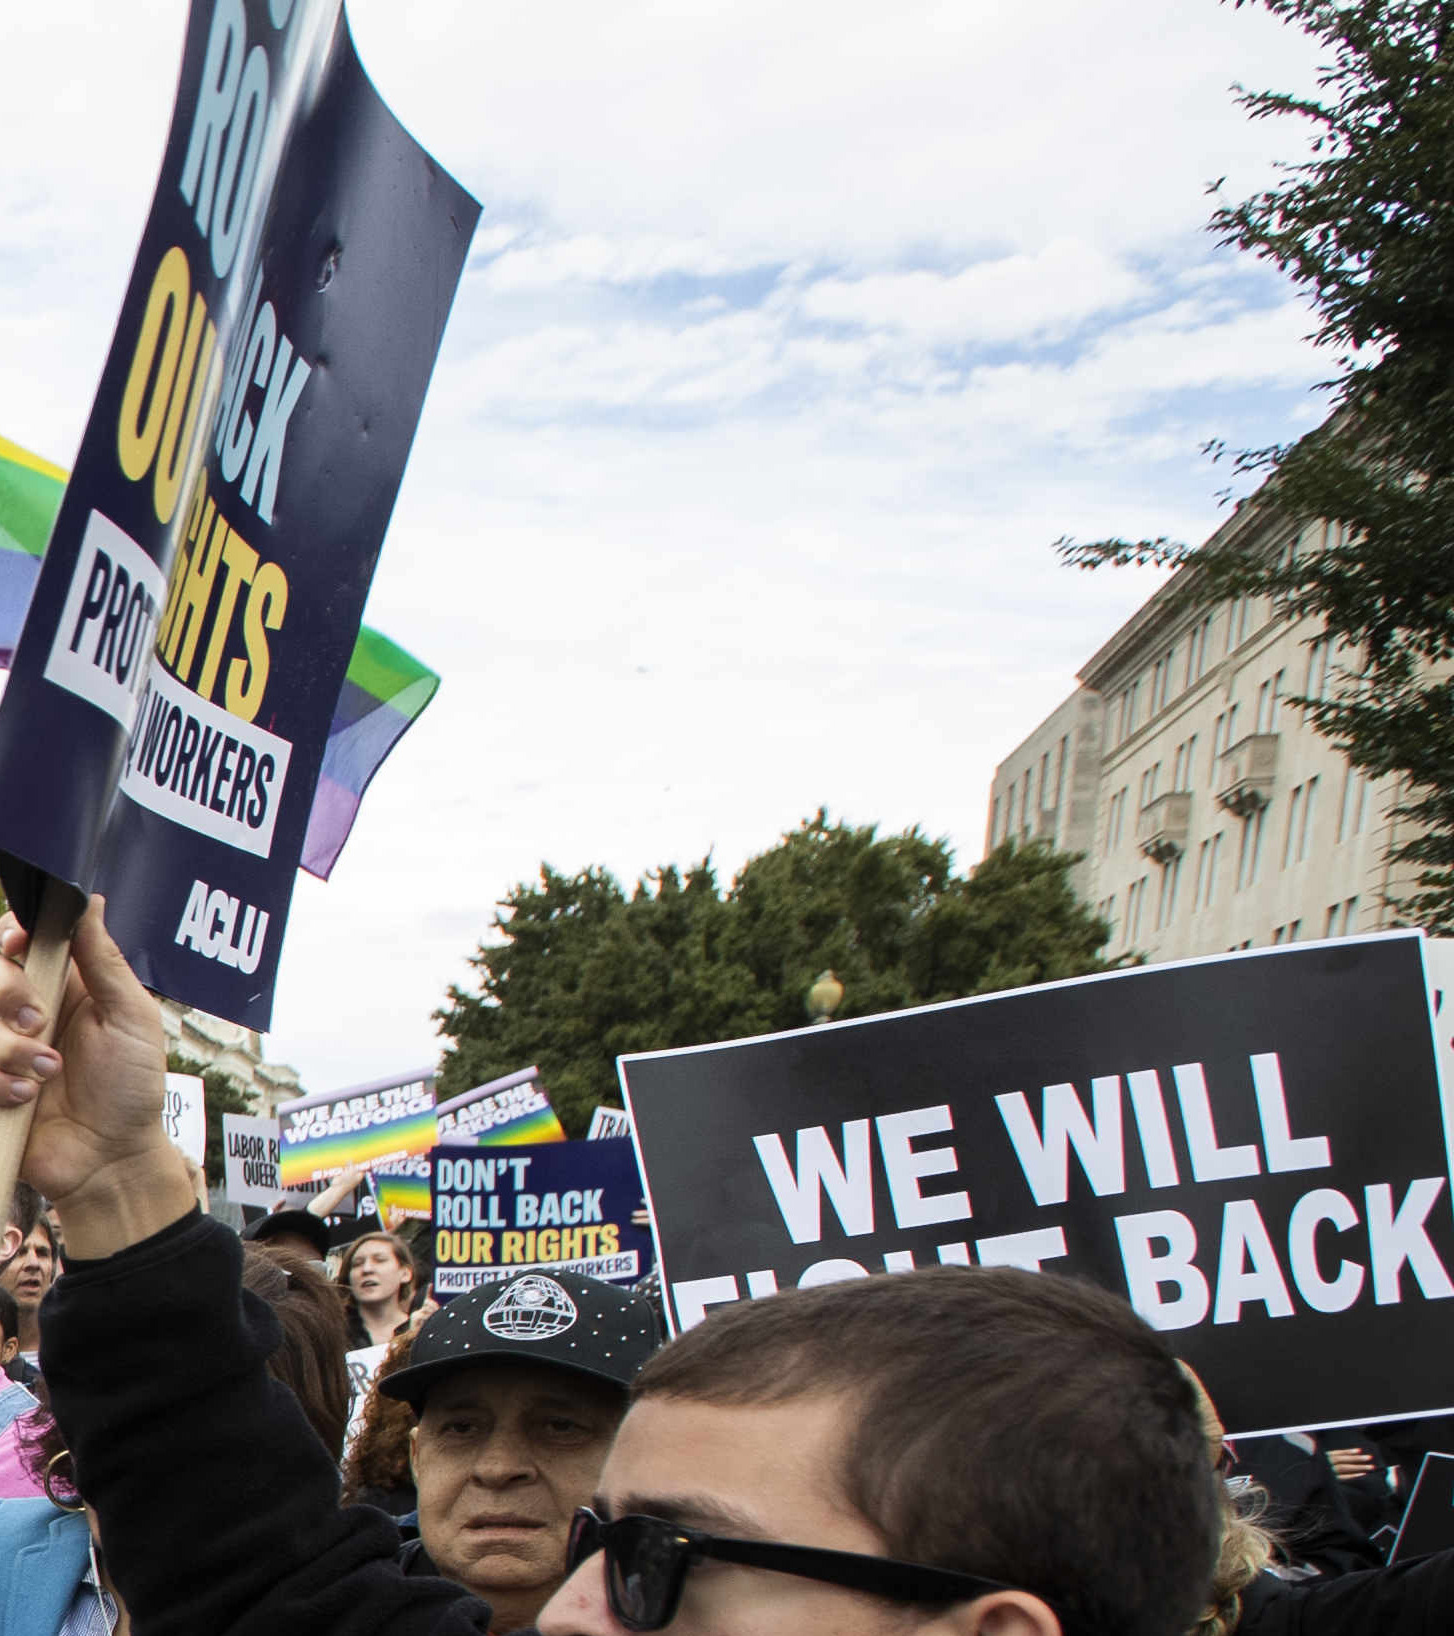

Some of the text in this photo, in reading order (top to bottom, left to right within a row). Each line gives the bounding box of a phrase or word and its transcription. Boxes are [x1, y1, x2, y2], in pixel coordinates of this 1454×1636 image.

[117, 246, 222, 524] OU
[69, 547, 161, 695] PROT
[157, 468, 289, 724] GHTS
[137, 690, 276, 830] WORKERS
[175, 879, 269, 976] ACLU
[284, 1093, 435, 1145] WORKFORCE
[291, 1080, 426, 1129] WE ARE THE
[228, 1132, 266, 1158] LABOR
[243, 1160, 279, 1189] QUEER
[436, 1157, 532, 1192] DON'T
[753, 1051, 1332, 1244] WE WILL
[436, 1188, 605, 1228] ROLL BACK
[436, 1224, 620, 1263] OUR RIGHTS
[1114, 1176, 1454, 1331] BACK
